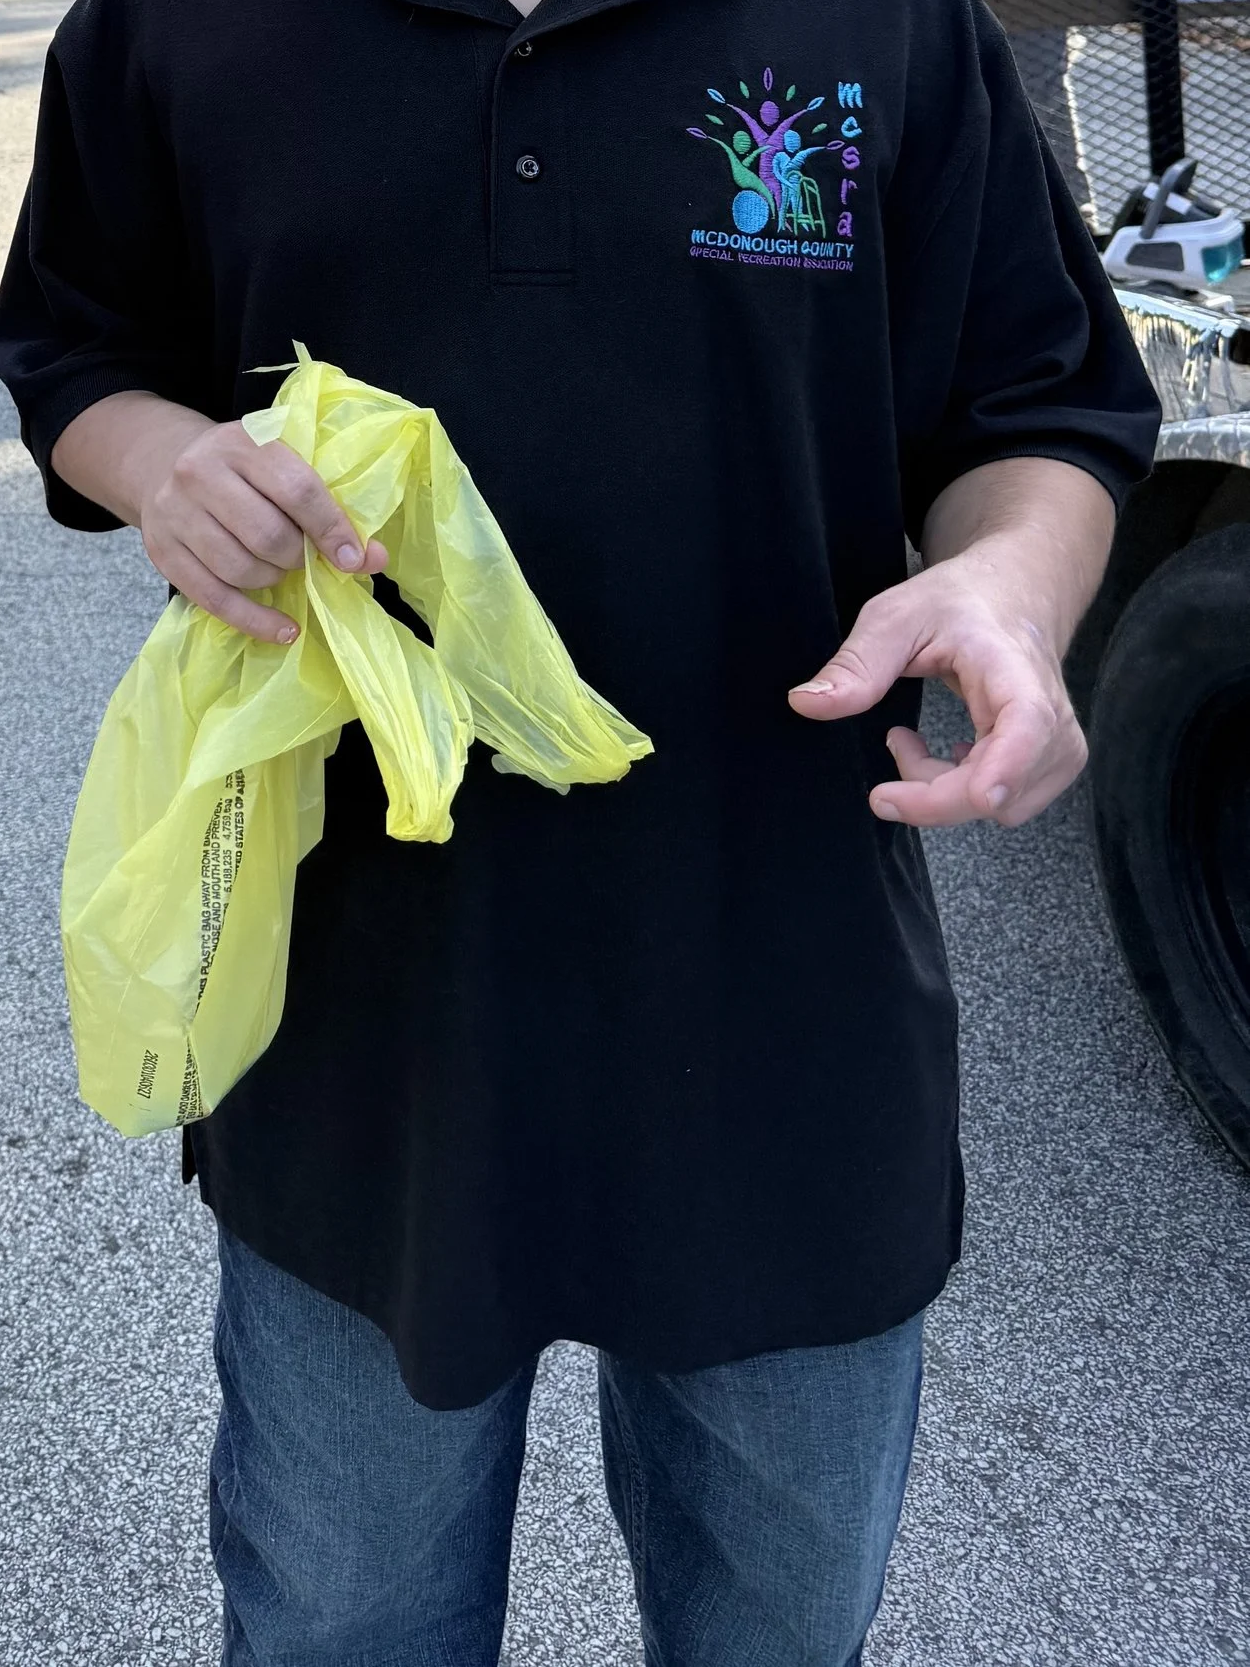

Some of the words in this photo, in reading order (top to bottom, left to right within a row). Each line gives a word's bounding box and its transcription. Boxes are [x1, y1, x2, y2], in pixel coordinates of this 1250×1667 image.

[235, 796, 244, 809] OF
[235, 811, 244, 848] STATES
[202, 847, 211, 878] FROM
[211, 841, 220, 863] AND
[202, 880, 211, 908] AWAY
[211, 864, 221, 899] MOUTH
[202, 910, 211, 932] BAG
[212, 901, 221, 923] AND
[201, 935, 211, 975] PLASTIC
